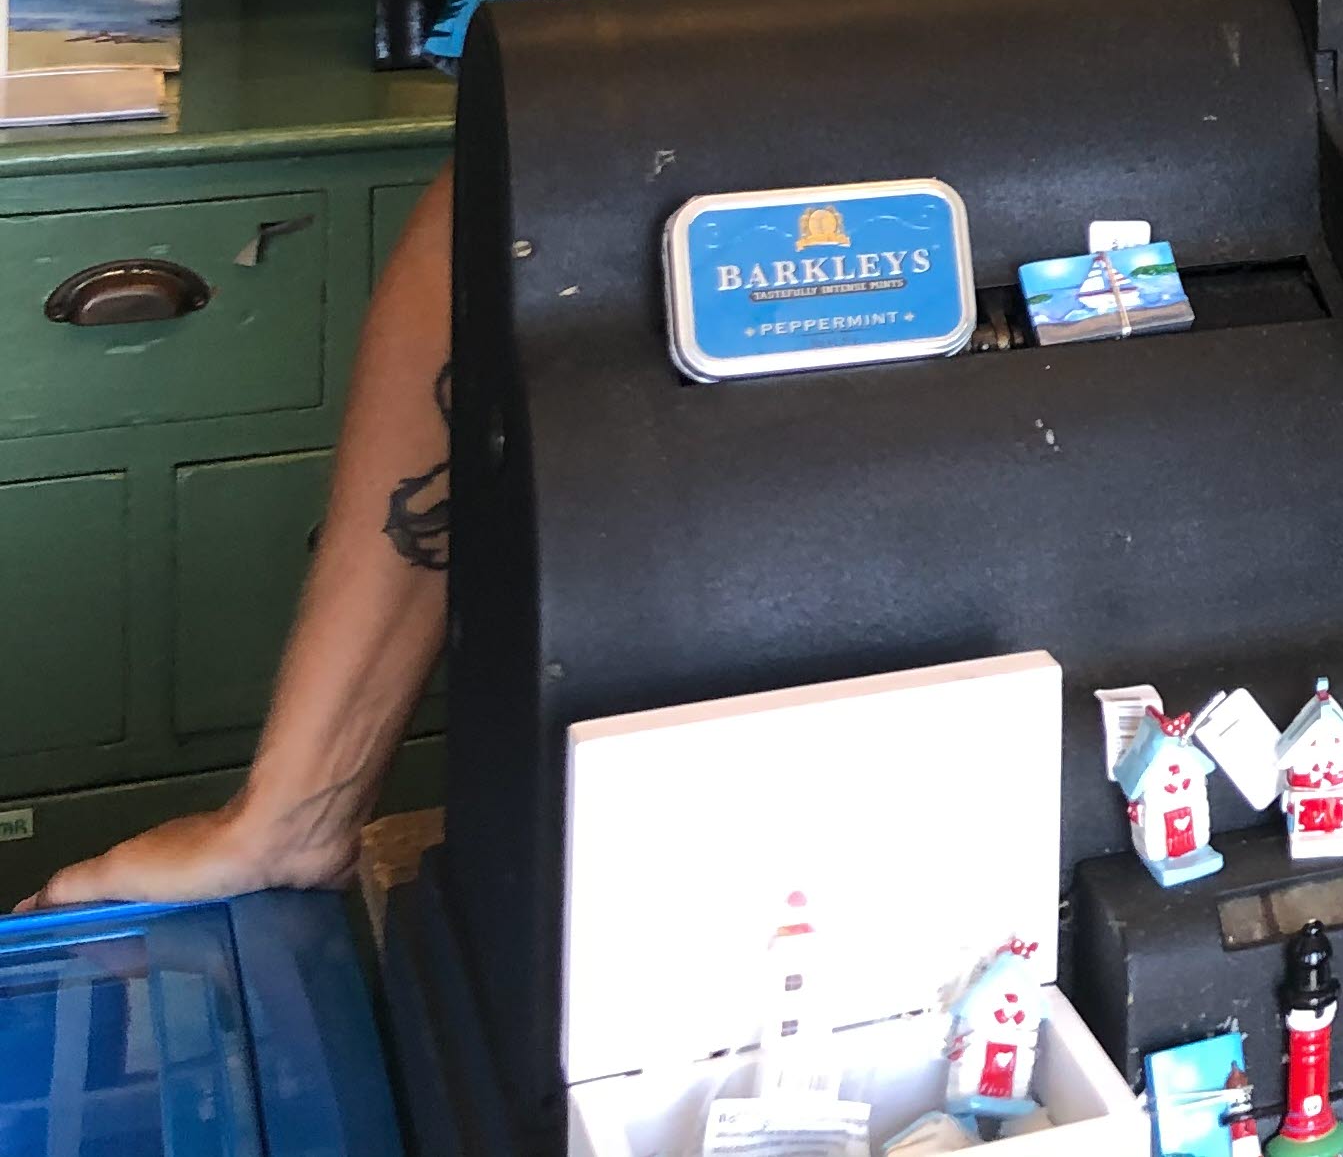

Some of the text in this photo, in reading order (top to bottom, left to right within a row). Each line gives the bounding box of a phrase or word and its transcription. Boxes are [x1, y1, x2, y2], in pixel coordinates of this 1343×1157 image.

[716, 248, 932, 292] BARKLEYS
[753, 278, 904, 301] TASTEFULLY INTENSE MINTS
[759, 311, 899, 337] PEPPERMINT
